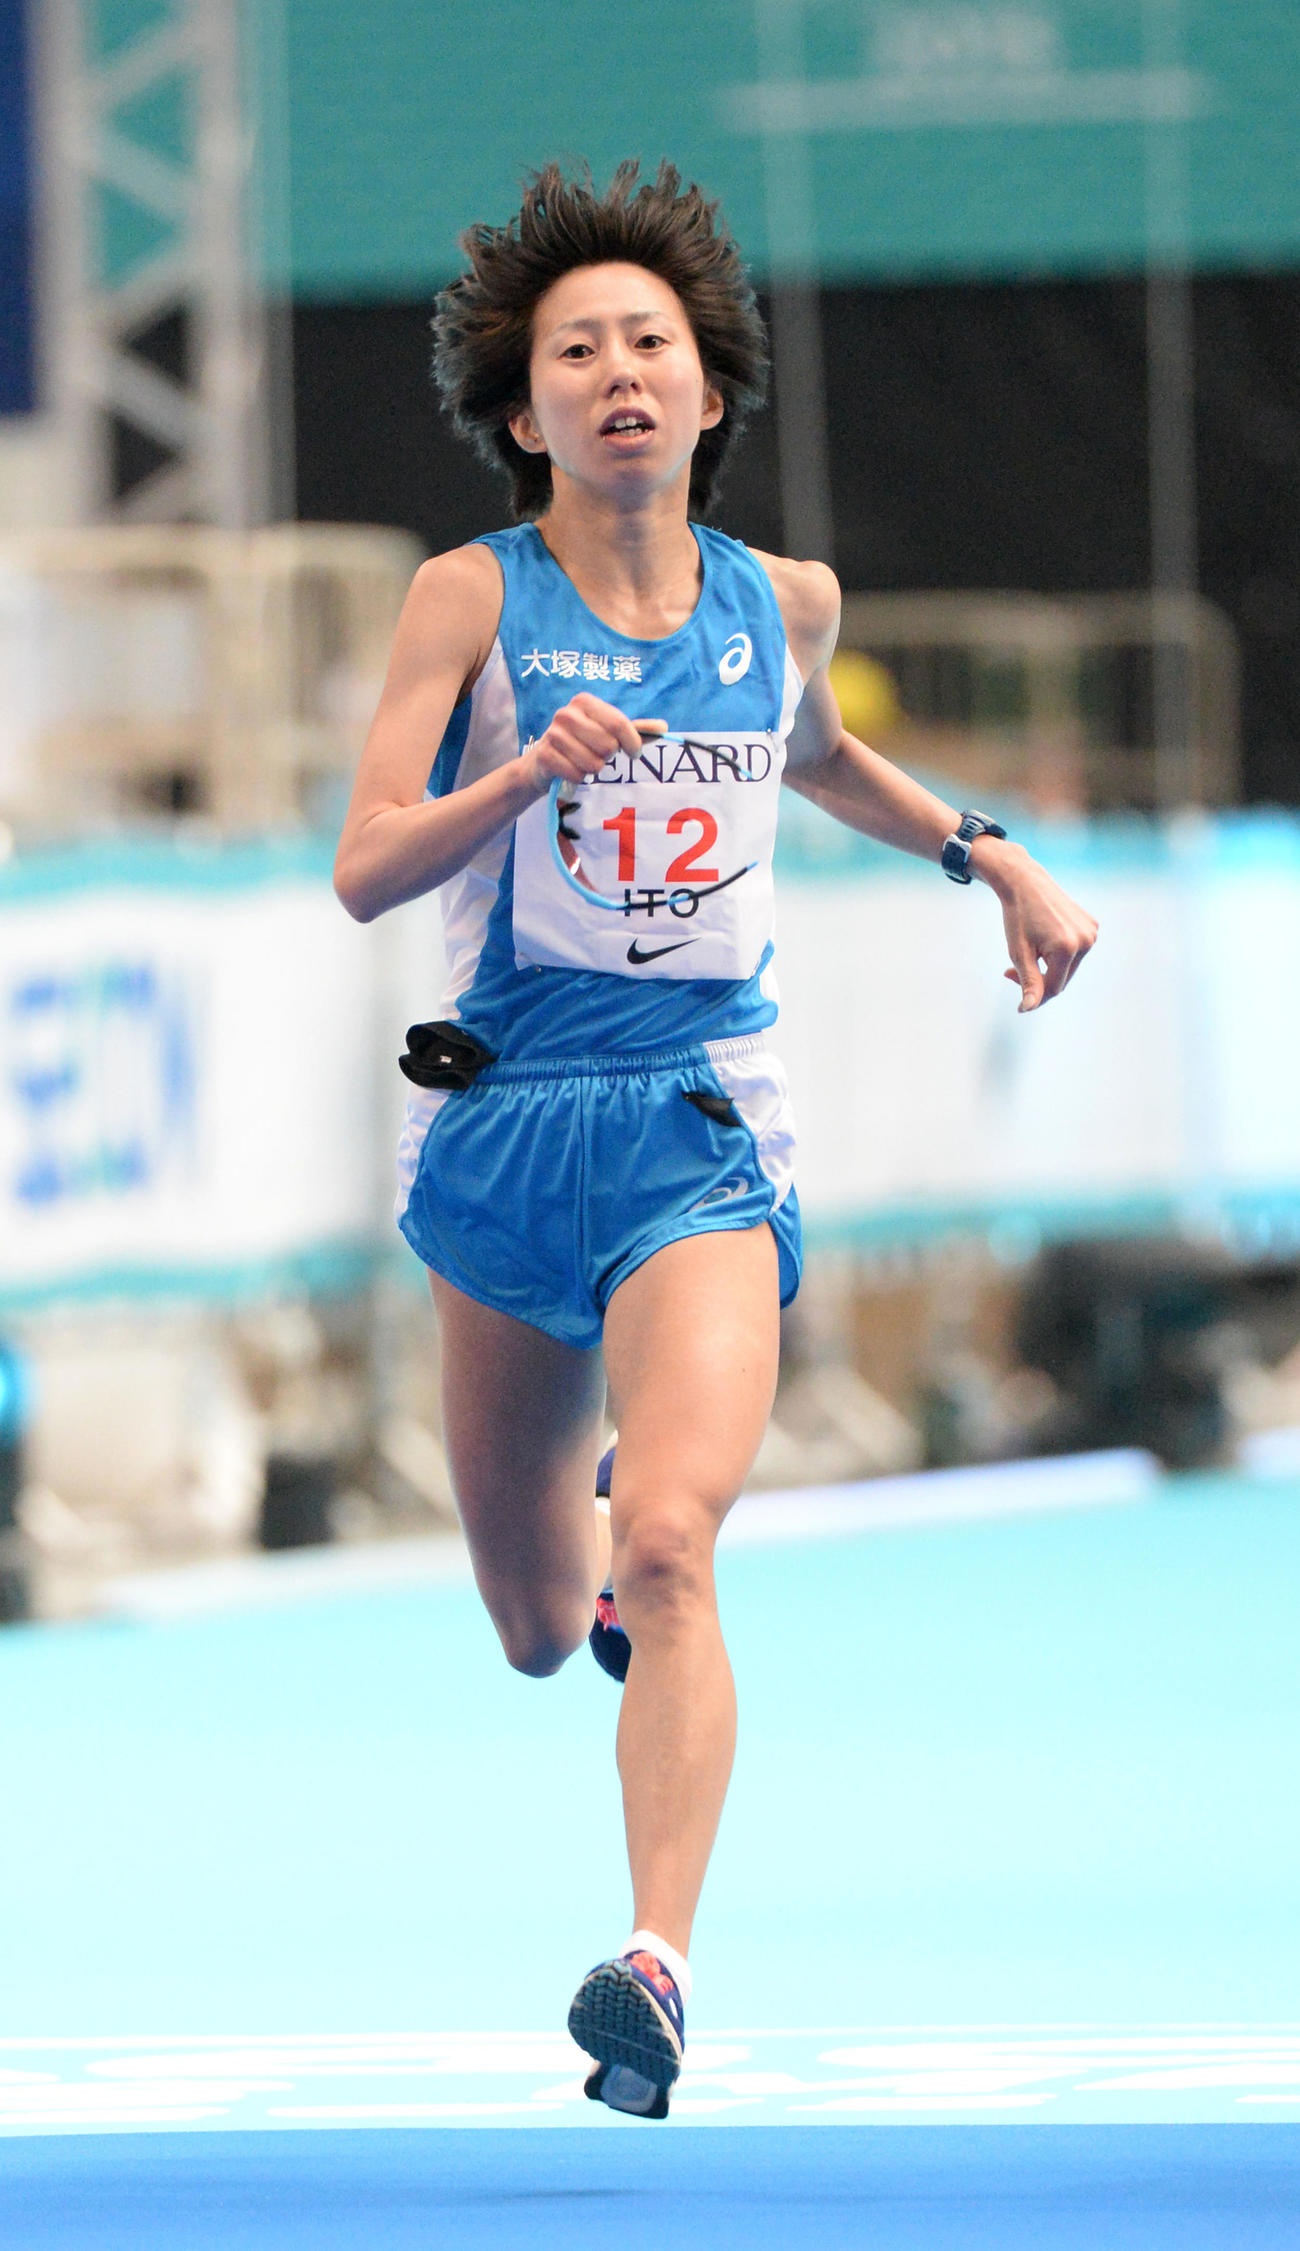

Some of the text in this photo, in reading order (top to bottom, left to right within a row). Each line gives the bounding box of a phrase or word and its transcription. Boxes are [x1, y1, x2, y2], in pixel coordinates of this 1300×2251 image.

[521, 648, 642, 682] 大塚製薬
[579, 743, 772, 784] ENARD
[602, 807, 719, 882] 12
[624, 888, 700, 918] ITO
